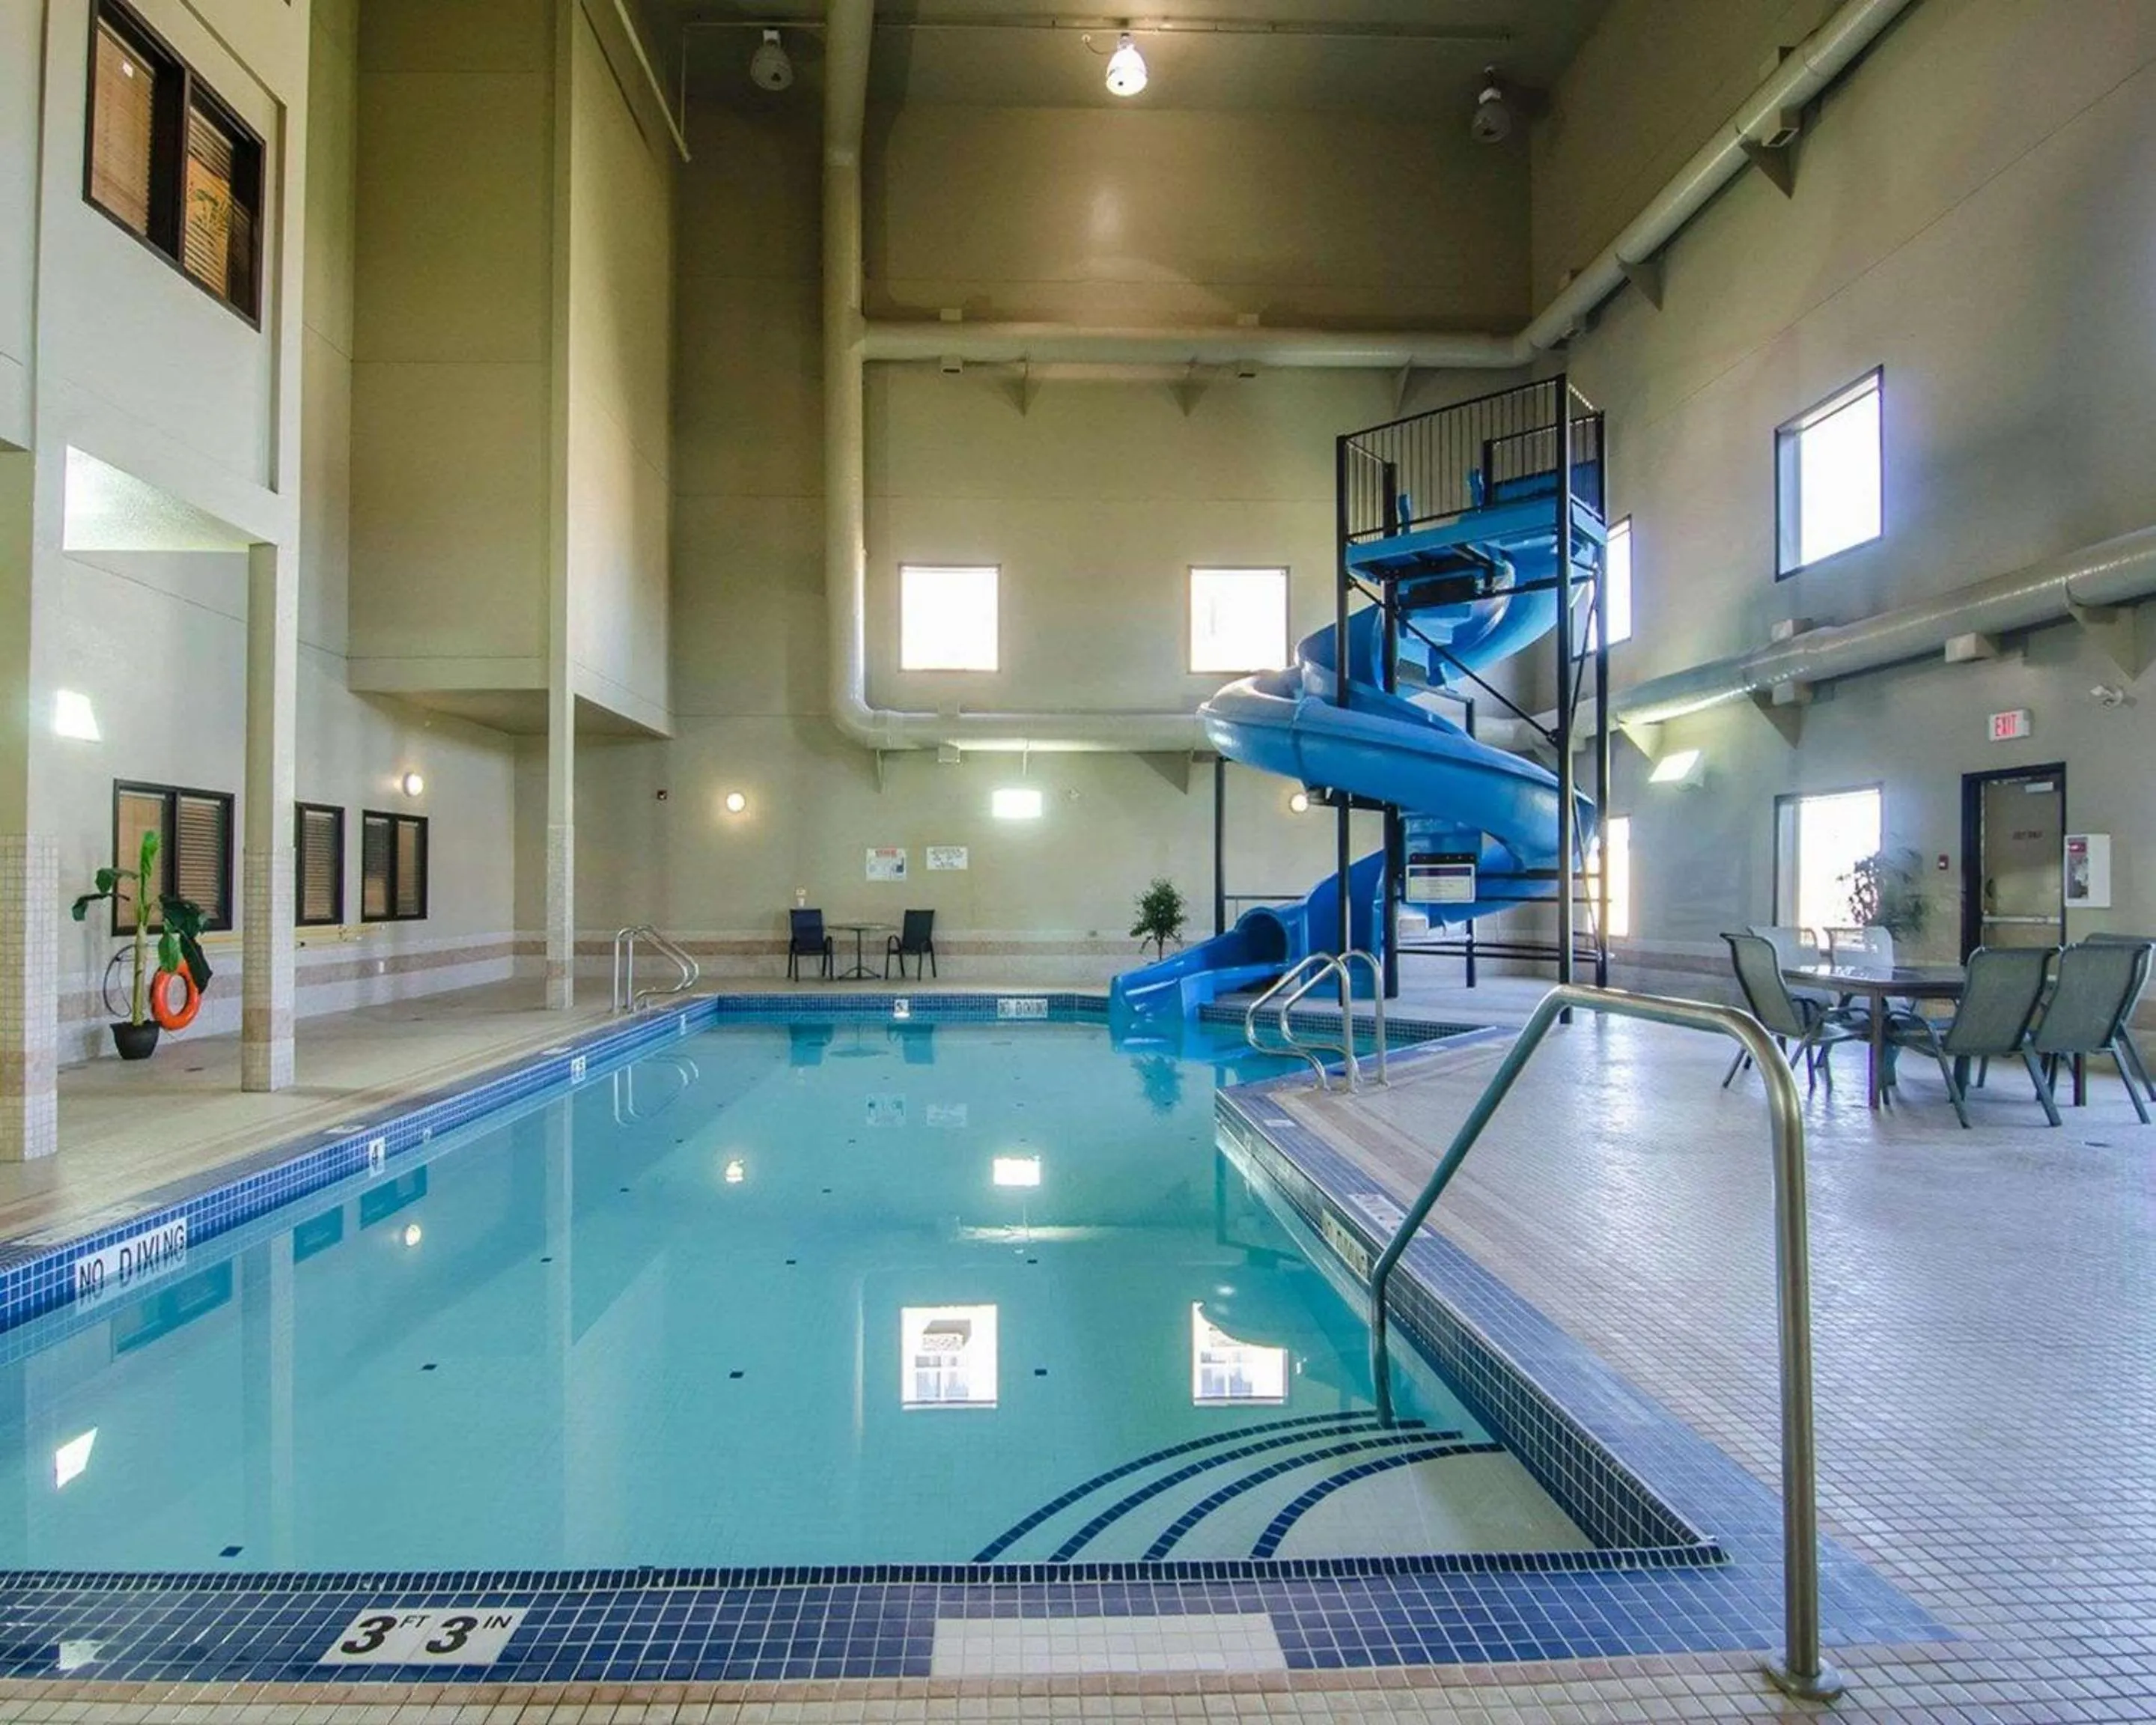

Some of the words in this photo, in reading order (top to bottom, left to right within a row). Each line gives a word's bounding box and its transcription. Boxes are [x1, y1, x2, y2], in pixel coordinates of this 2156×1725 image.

[1994, 714, 2017, 737] EXIT
[79, 1259, 104, 1297] NO
[119, 1225, 184, 1282] DIVING
[341, 1616, 397, 1654] 3
[399, 1615, 430, 1628] FT
[425, 1616, 478, 1654] 3
[483, 1615, 513, 1629] IN
